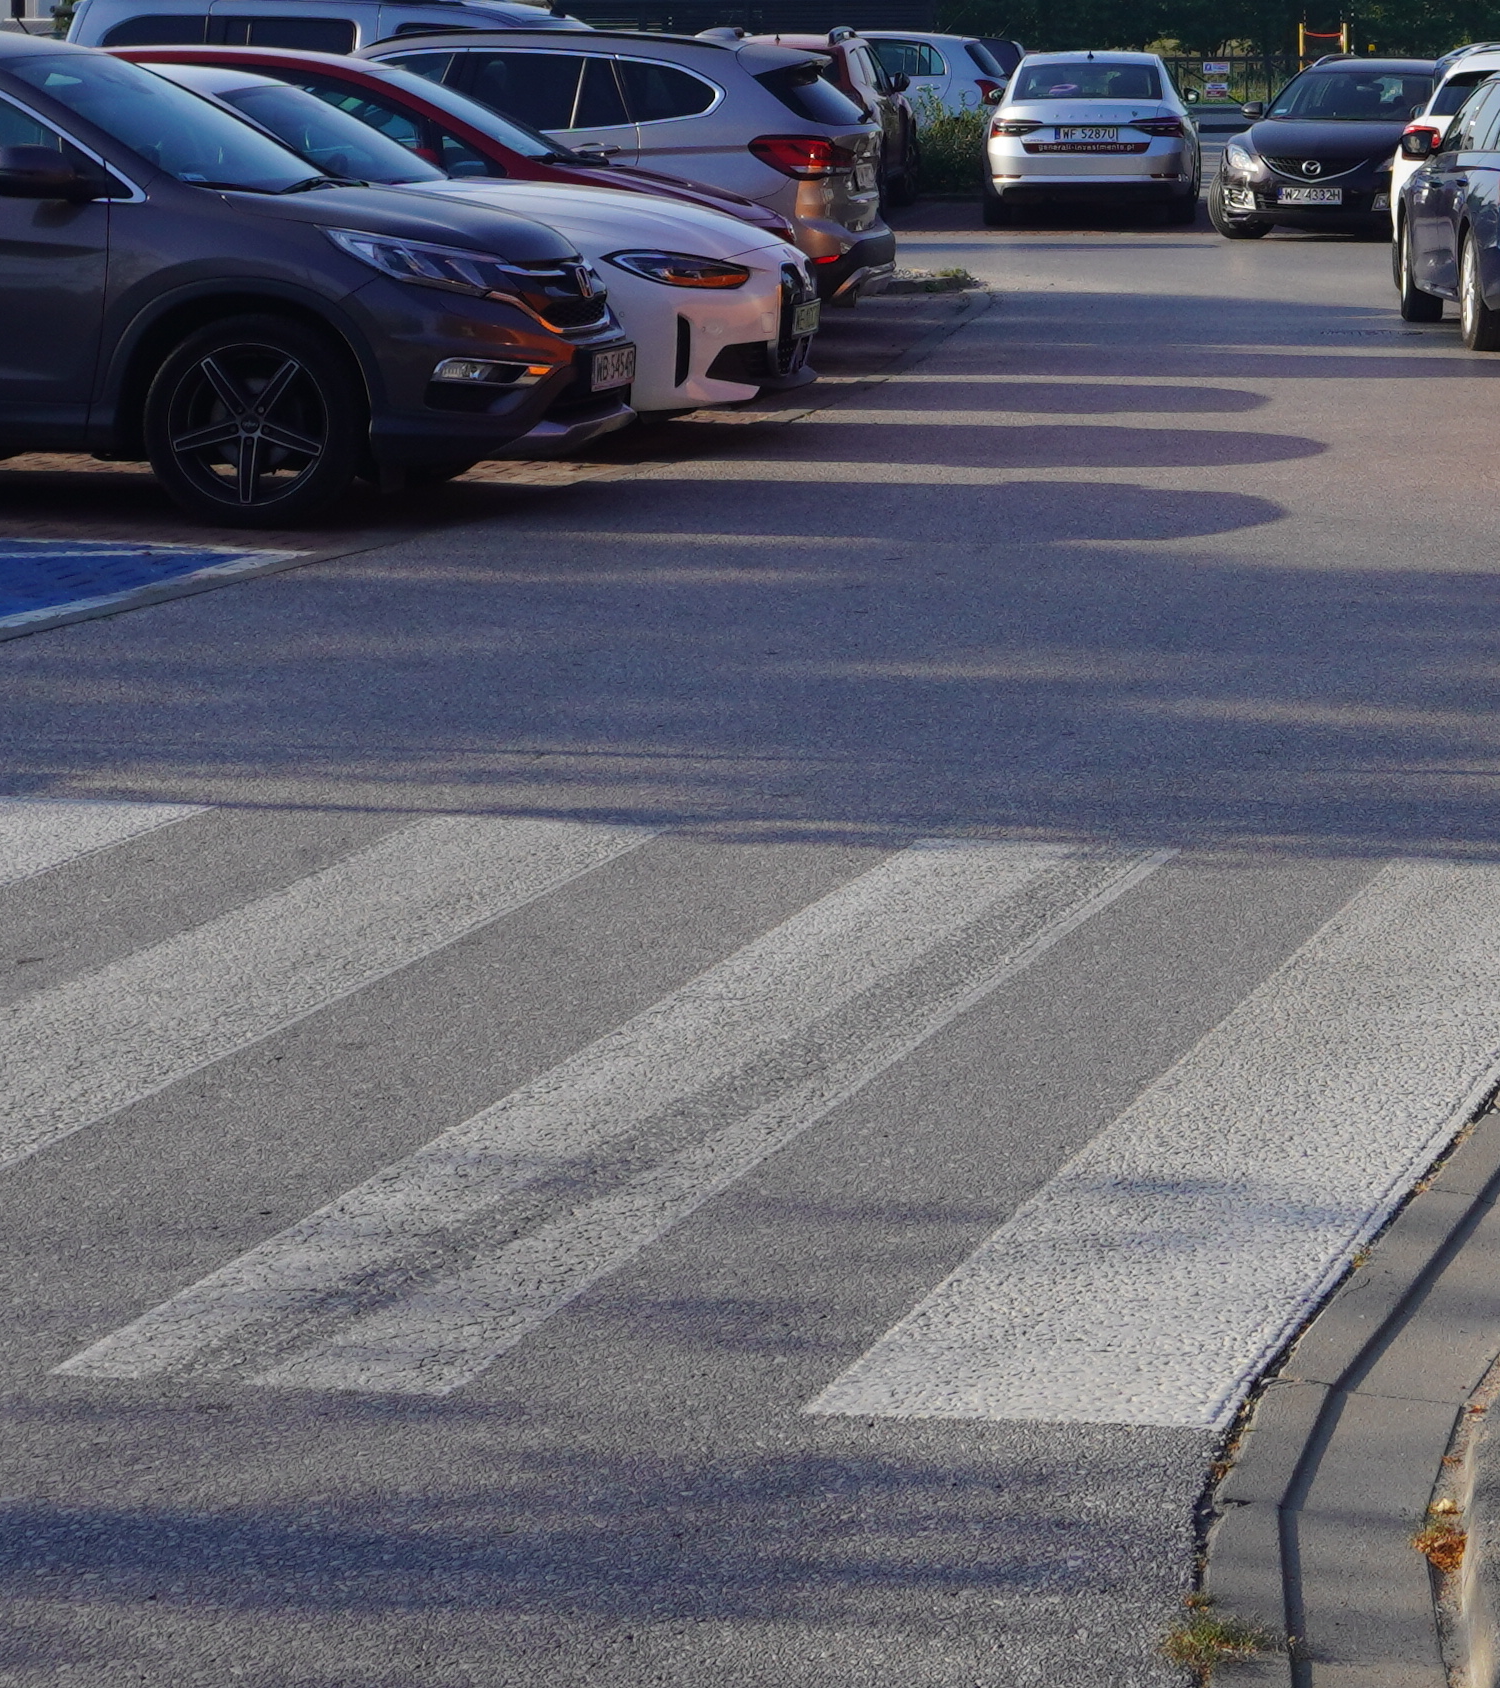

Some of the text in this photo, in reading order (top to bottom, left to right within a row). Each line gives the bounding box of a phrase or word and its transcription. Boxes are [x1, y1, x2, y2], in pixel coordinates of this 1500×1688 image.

[1062, 128, 1116, 140] WF 5287U
[1284, 188, 1341, 200] WZ 4332H
